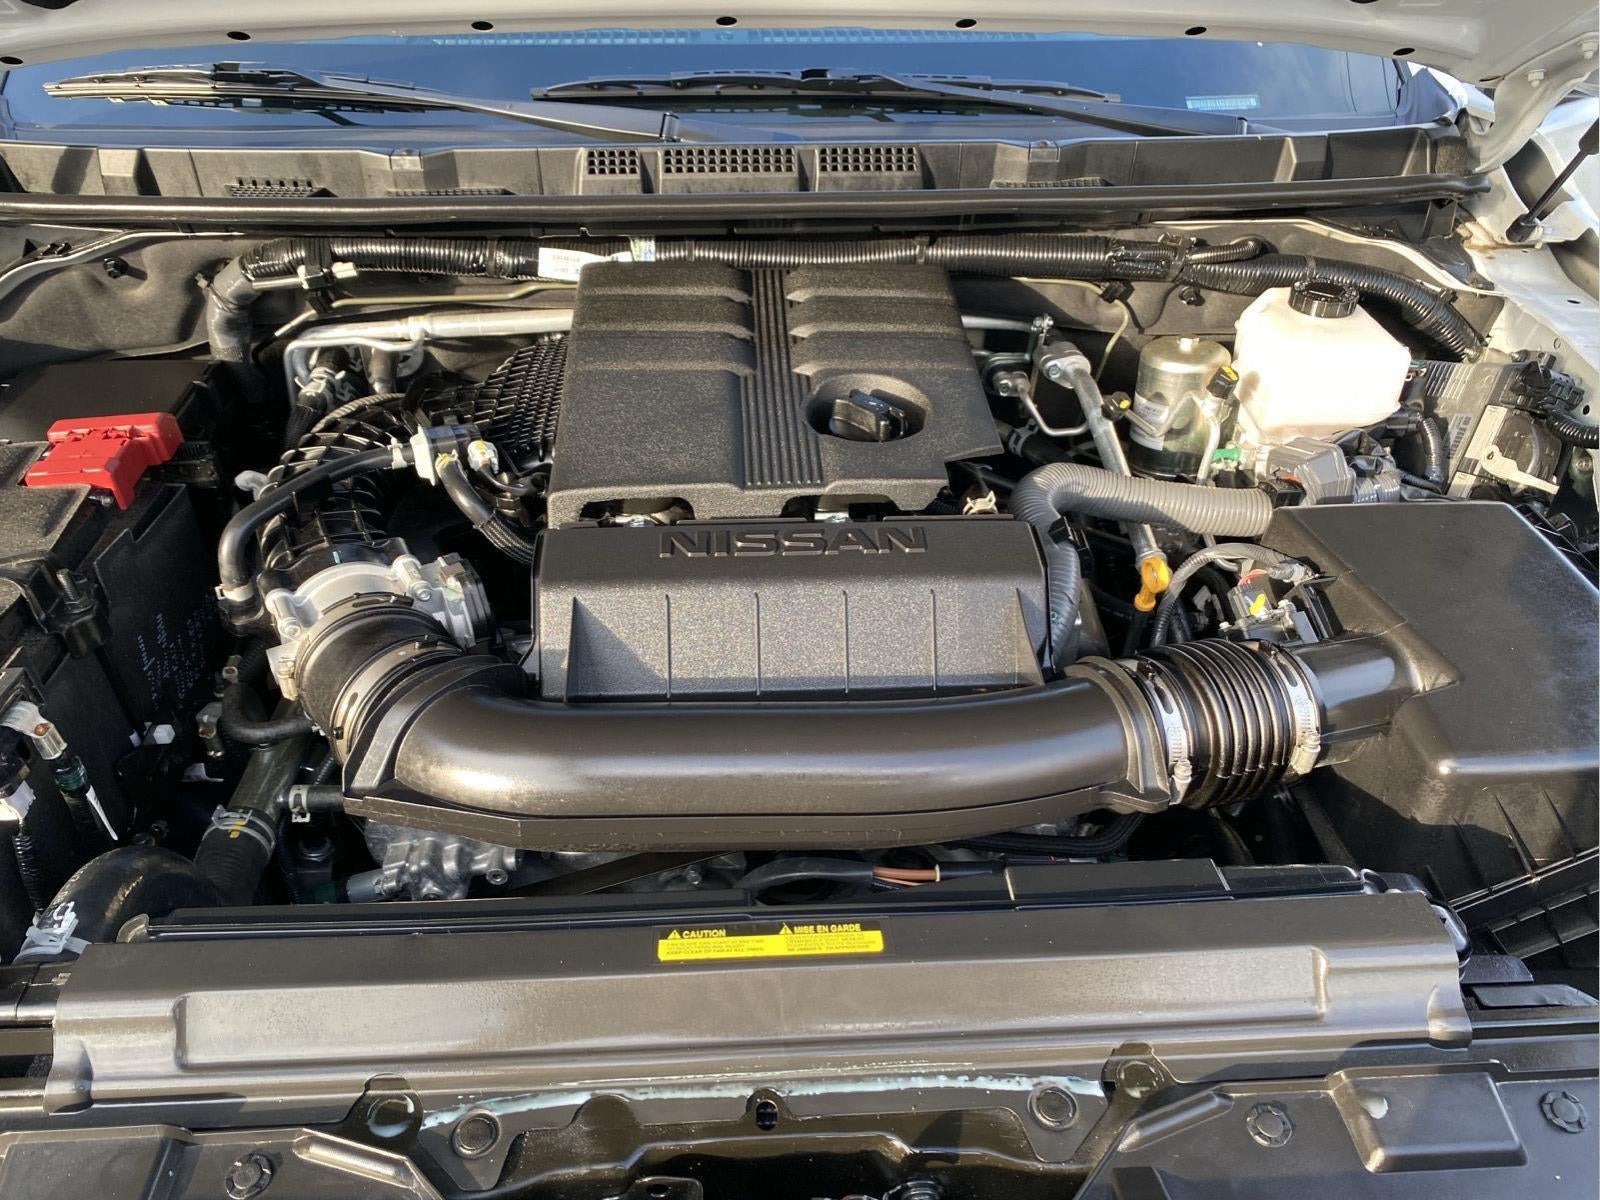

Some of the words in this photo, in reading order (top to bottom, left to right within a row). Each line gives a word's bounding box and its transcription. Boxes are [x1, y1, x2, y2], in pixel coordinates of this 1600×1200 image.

[659, 527, 928, 558] NISSAN
[682, 929, 726, 939] CAUTION
[793, 925, 815, 934] MISE
[816, 924, 829, 933] EN
[830, 923, 861, 932] GARDE
